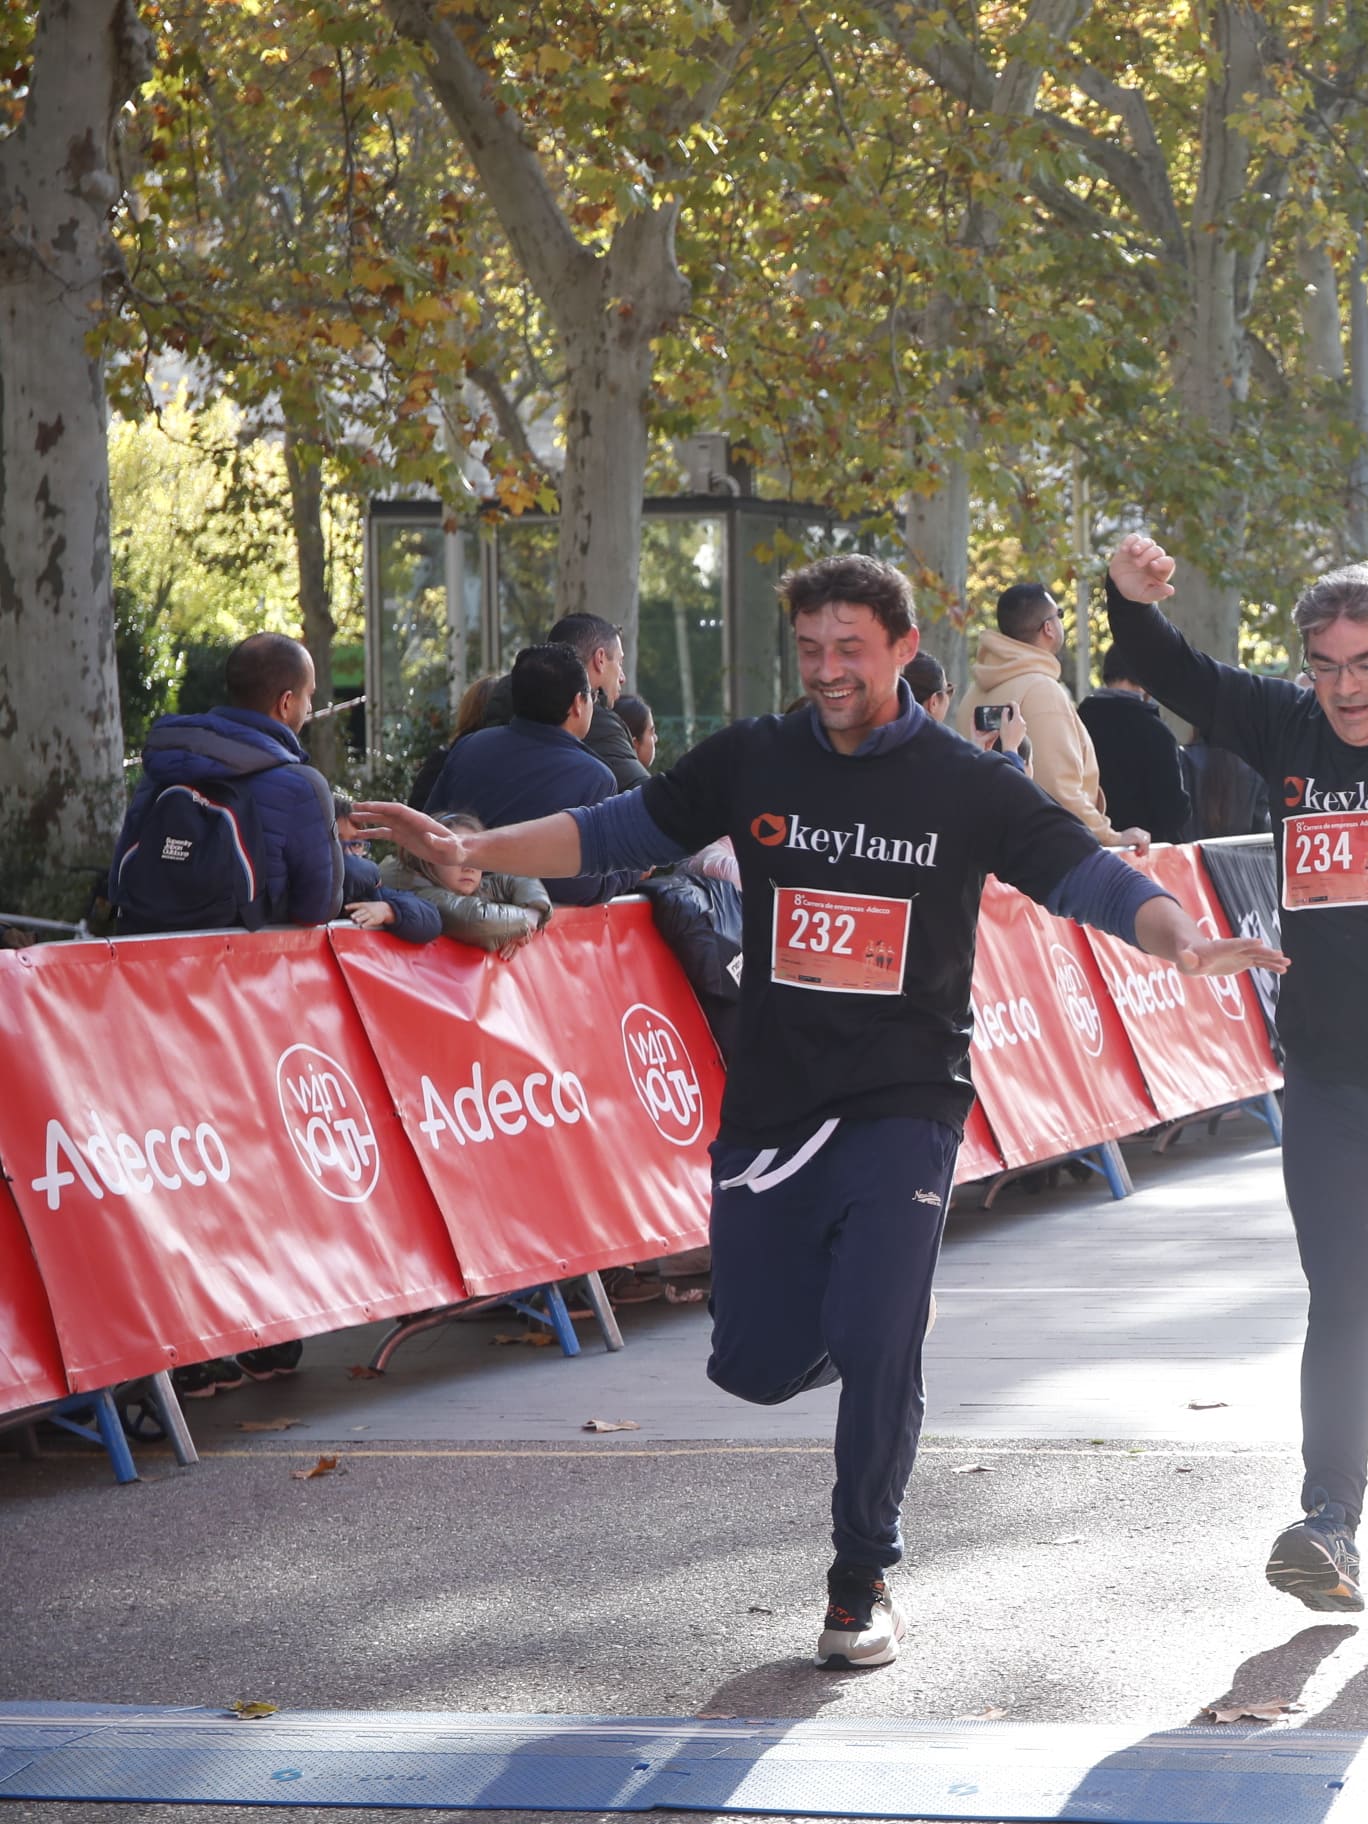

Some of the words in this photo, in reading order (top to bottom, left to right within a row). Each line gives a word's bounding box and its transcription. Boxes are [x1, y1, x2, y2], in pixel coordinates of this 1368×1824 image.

[784, 814, 938, 868] keyland
[1296, 831, 1353, 874] 234
[788, 908, 856, 955] 232
[1113, 958, 1187, 1018] Adecco
[31, 1109, 231, 1211] Adecco
